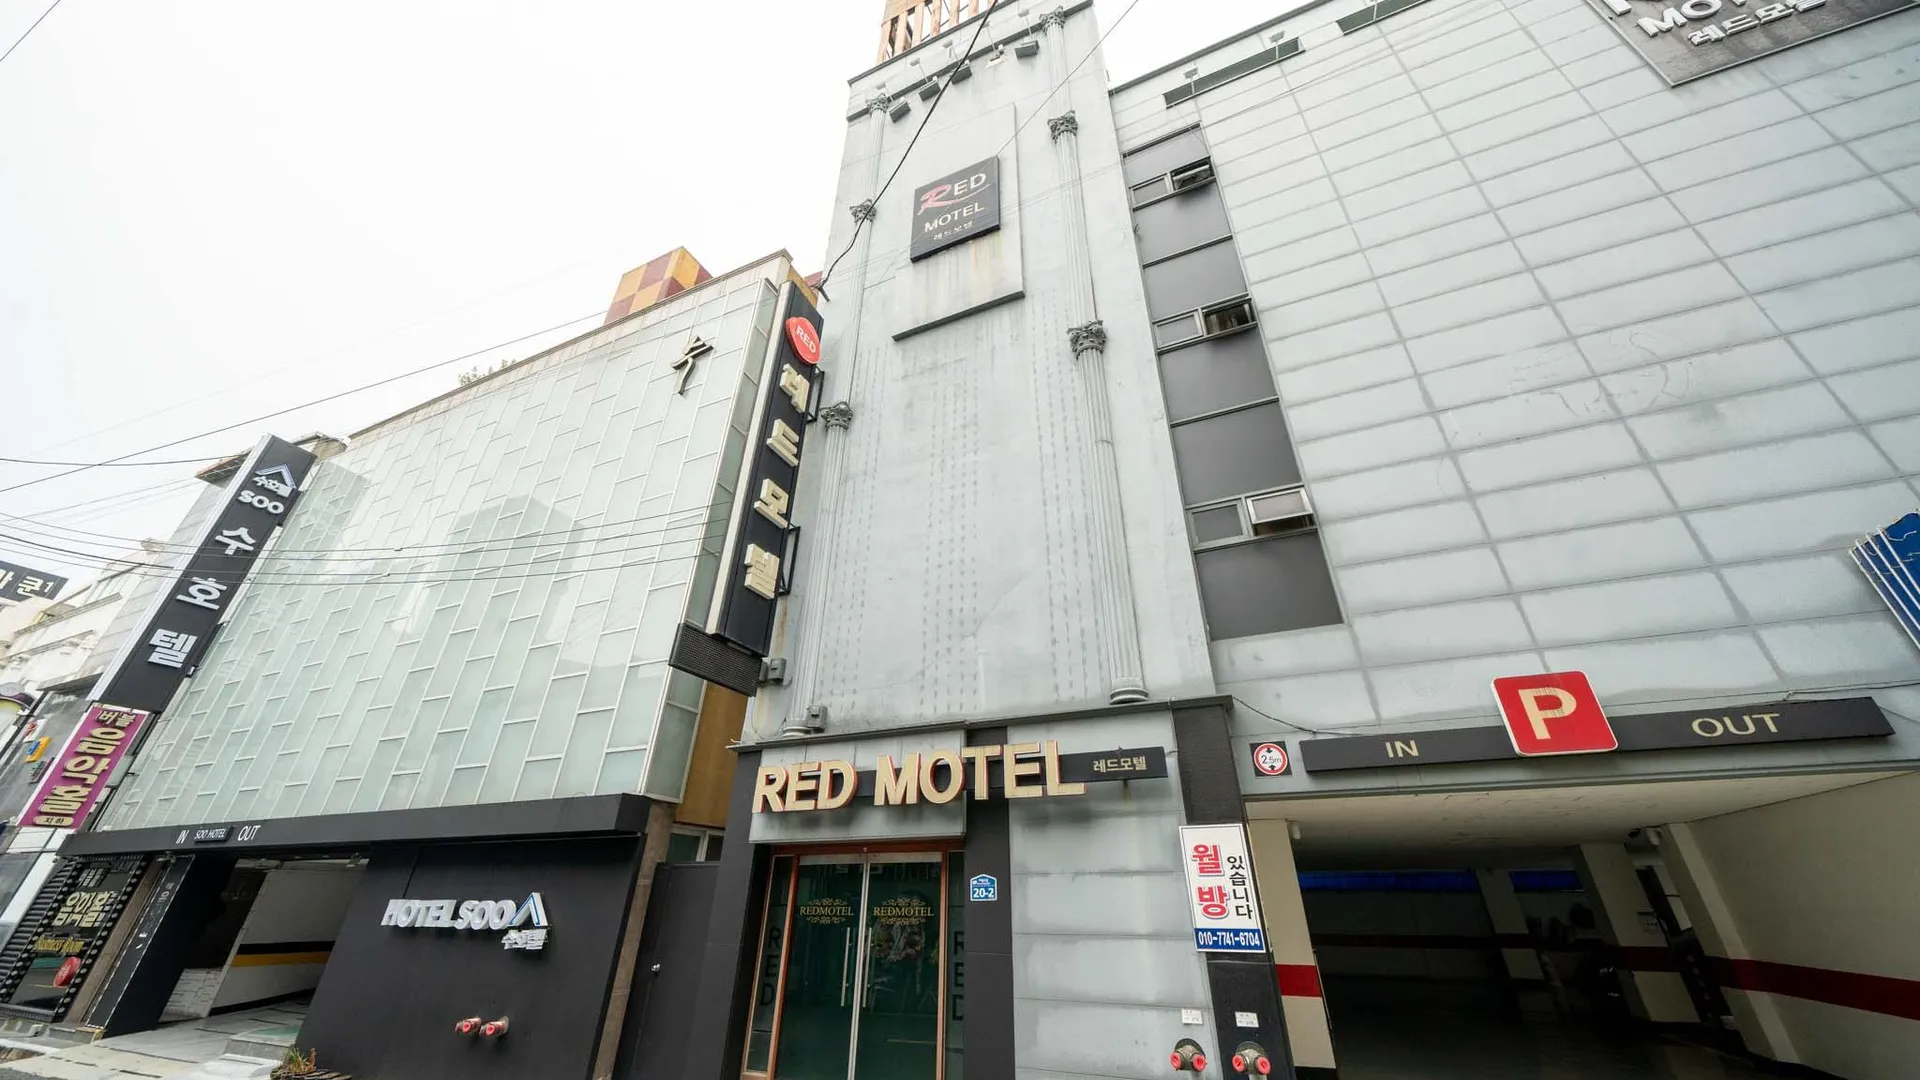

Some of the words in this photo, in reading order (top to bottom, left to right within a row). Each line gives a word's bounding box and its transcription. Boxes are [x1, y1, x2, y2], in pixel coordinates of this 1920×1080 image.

[1637, 0, 1747, 37] MO
[917, 172, 990, 216] RED
[924, 202, 985, 232] MOTEL
[796, 326, 816, 354] RED
[252, 475, 293, 498] 수호
[744, 363, 811, 600] 레드모텔
[147, 527, 257, 668] 수호텔
[1385, 740, 1419, 758] IN
[1518, 687, 1577, 740] P
[1691, 712, 1780, 737] OUT
[39, 727, 126, 815] 음악홀
[752, 759, 858, 814] RED
[873, 740, 1086, 806] MOTEL
[1093, 755, 1147, 773] 레드모텔
[175, 829, 190, 844] IN
[193, 829, 208, 840] SOO
[207, 828, 227, 839] HOTEL
[237, 824, 262, 842] OUT
[972, 887, 995, 898] 20-2
[1226, 855, 1253, 920] 있습니다
[380, 899, 457, 928] HOTEL
[453, 899, 518, 930] SOO
[799, 905, 854, 917] REDMOTEL
[873, 905, 934, 918] REDMOTEL
[1198, 931, 1261, 947] 010-7741-6704
[759, 926, 782, 1007] RED
